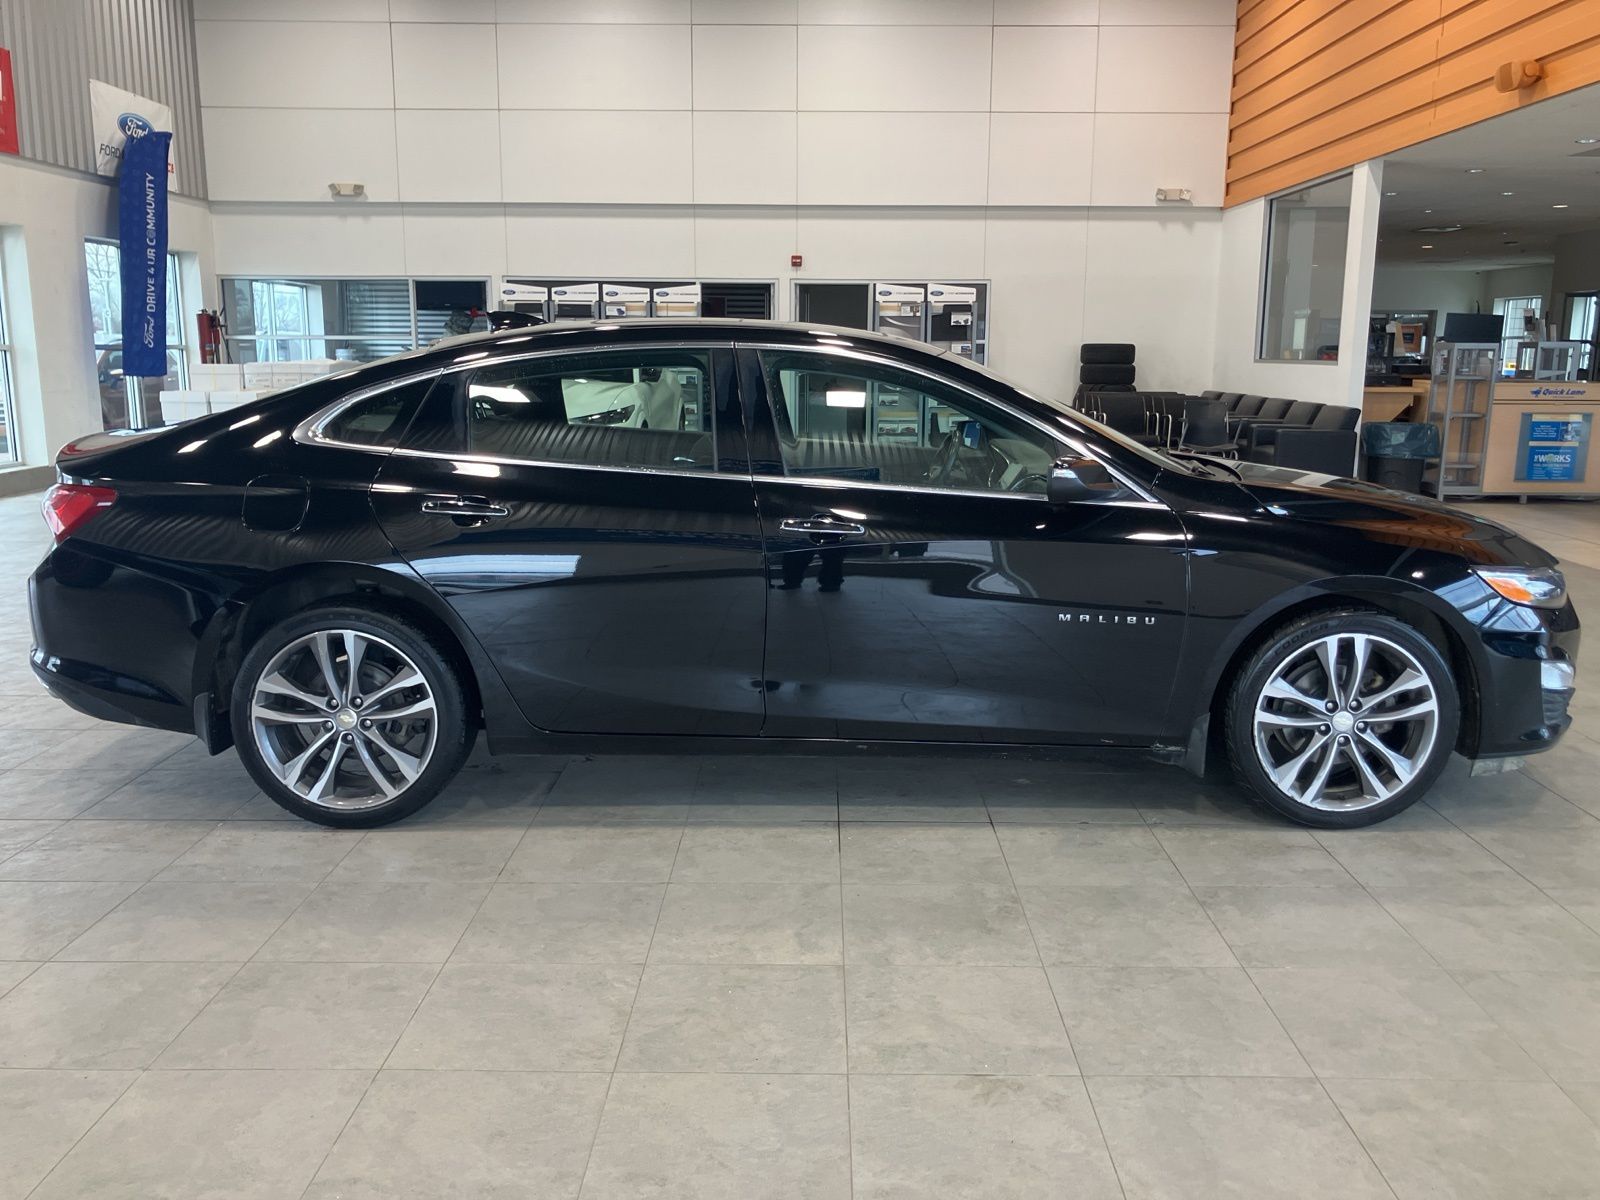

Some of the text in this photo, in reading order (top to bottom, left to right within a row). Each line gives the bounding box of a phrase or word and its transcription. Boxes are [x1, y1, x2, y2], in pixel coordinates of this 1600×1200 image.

[125, 117, 149, 139] Ford
[99, 143, 121, 159] FORD
[144, 172, 156, 348] Ford DRIVE 4 UR COMMUNITY
[1058, 613, 1155, 625] MALIBU
[1274, 622, 1330, 654] COOPER
